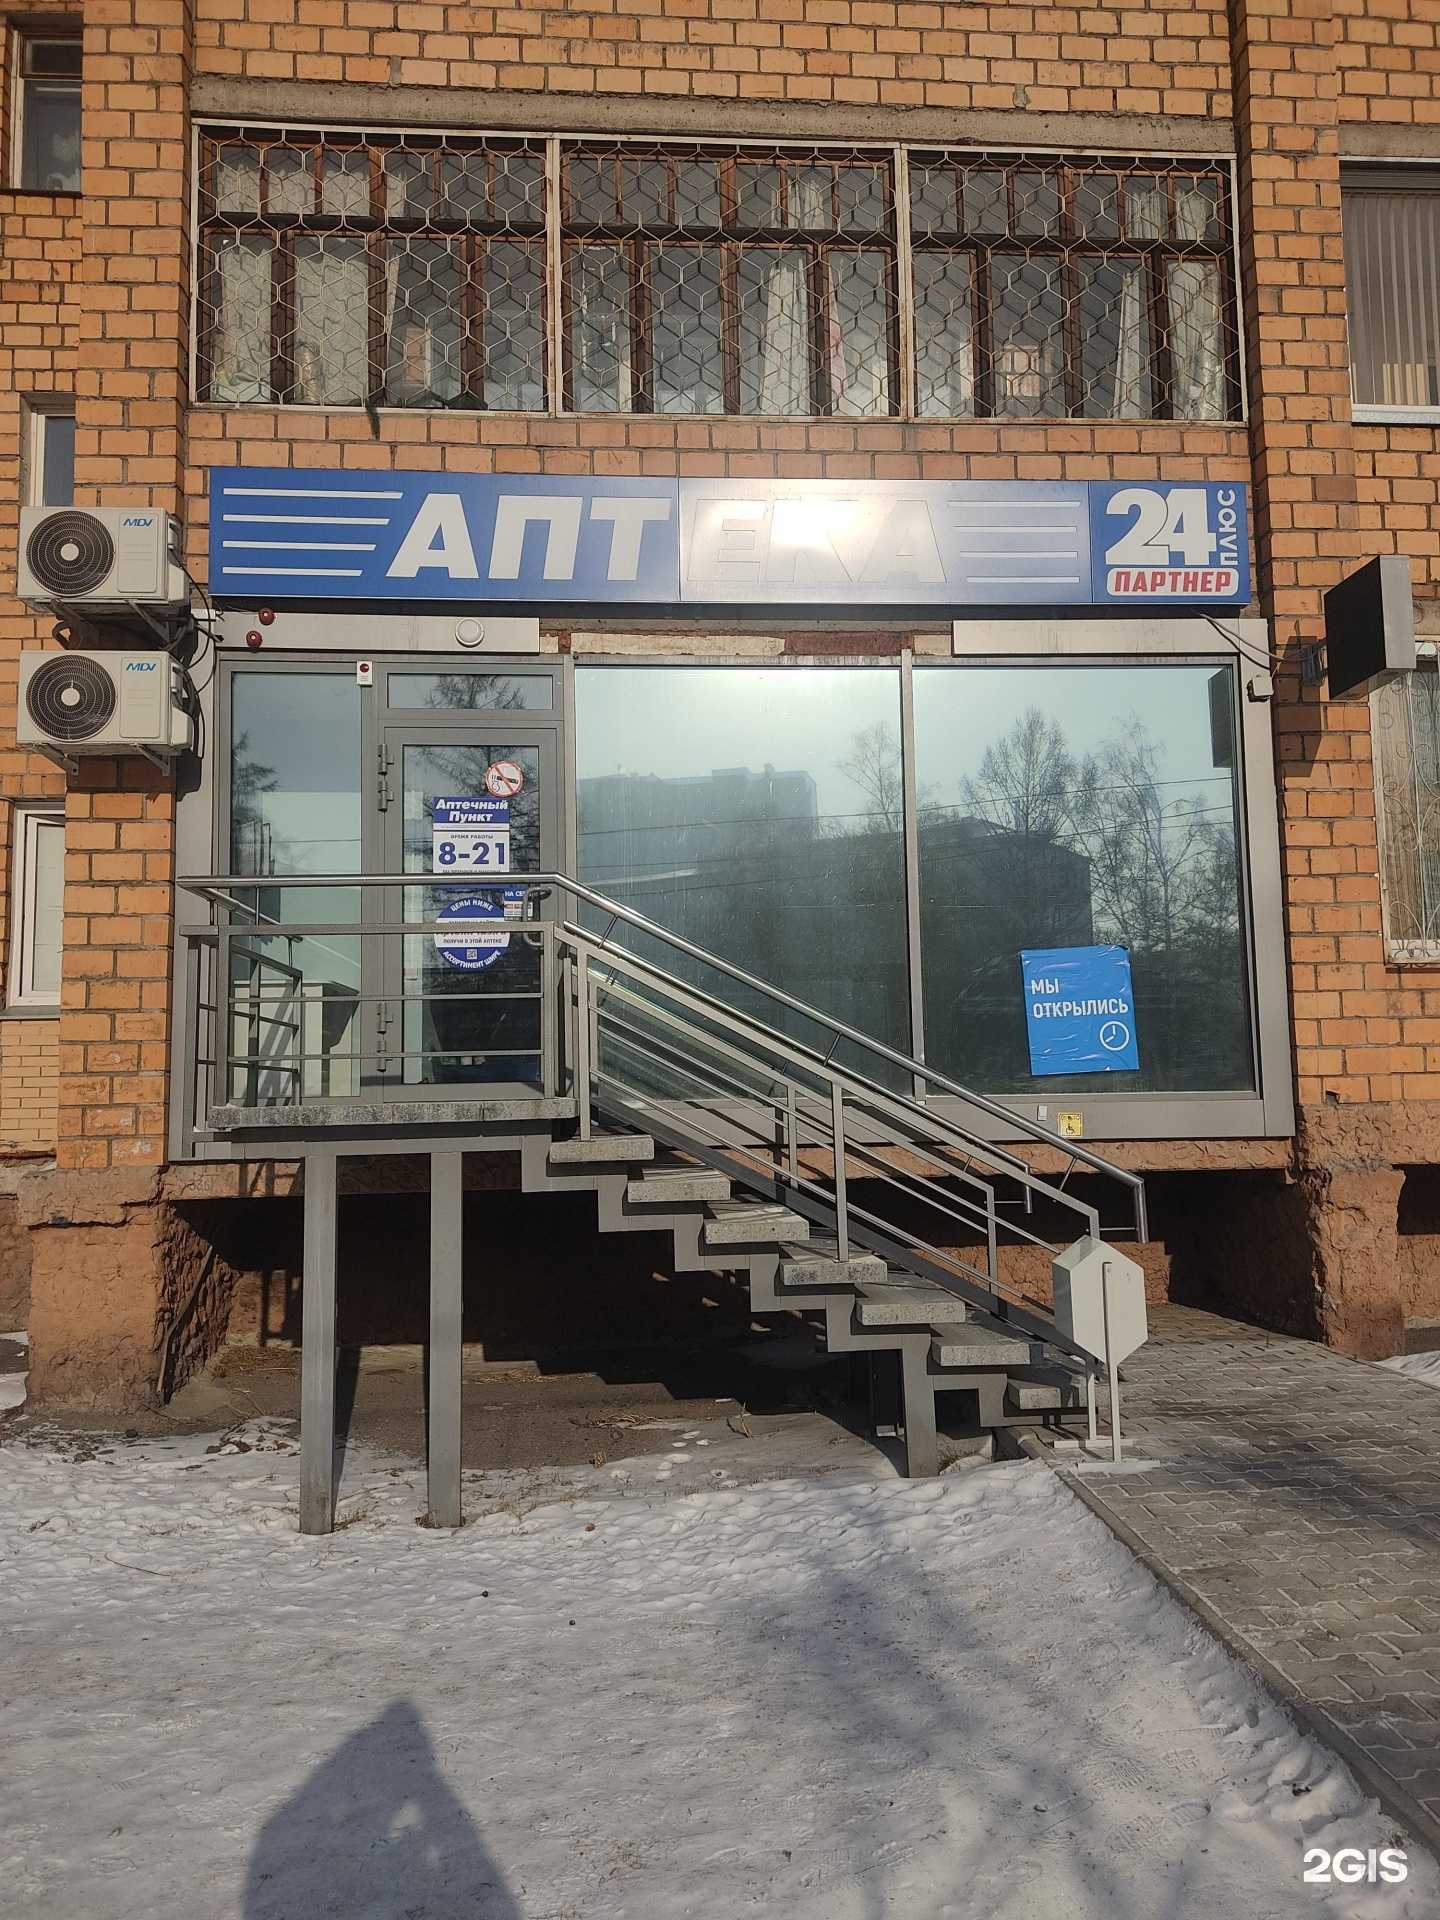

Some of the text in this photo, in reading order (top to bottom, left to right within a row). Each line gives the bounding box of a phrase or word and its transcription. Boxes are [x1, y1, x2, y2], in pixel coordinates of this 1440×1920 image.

[123, 518, 153, 527] MDV
[1105, 488, 1217, 566] 24
[1217, 489, 1239, 566] ПЛЮС
[386, 493, 949, 584] АПТЕКА
[1114, 570, 1232, 593] ПАРТНЕР
[126, 662, 157, 672] MDV
[435, 798, 509, 810] Аптечный
[448, 811, 494, 824] Пункт
[438, 841, 505, 866] 8-21
[450, 899, 471, 912] ЦЕНЫ
[472, 899, 494, 912] НИЖЕ
[442, 951, 484, 969] АССОРТИМЕНТ
[1031, 978, 1059, 995] МЫ
[1033, 998, 1129, 1019] ОТКРЫЛИСЬ
